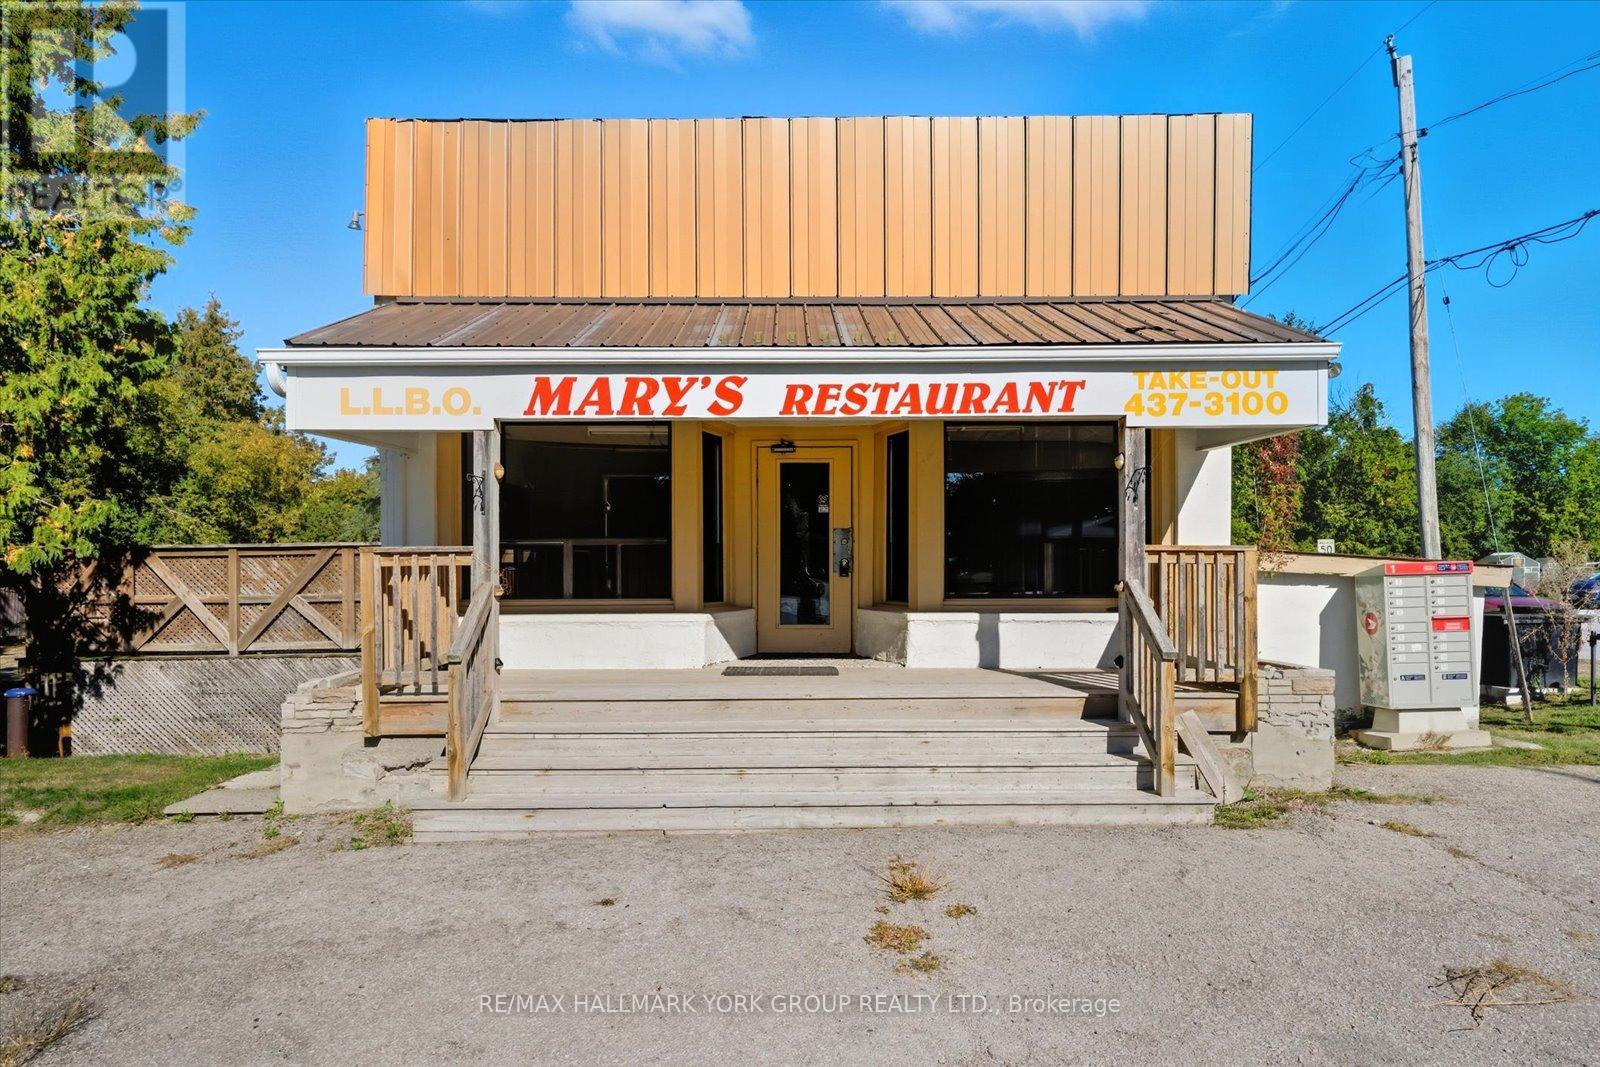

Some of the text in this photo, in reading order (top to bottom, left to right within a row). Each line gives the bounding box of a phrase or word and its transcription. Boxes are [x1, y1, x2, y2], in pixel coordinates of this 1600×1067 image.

[1132, 369, 1280, 392] TAKE-OUT
[340, 386, 481, 416] L.L.B.O.
[523, 375, 1086, 417] MARY'S RESTAURANT
[1124, 391, 1290, 418] 437-3100
